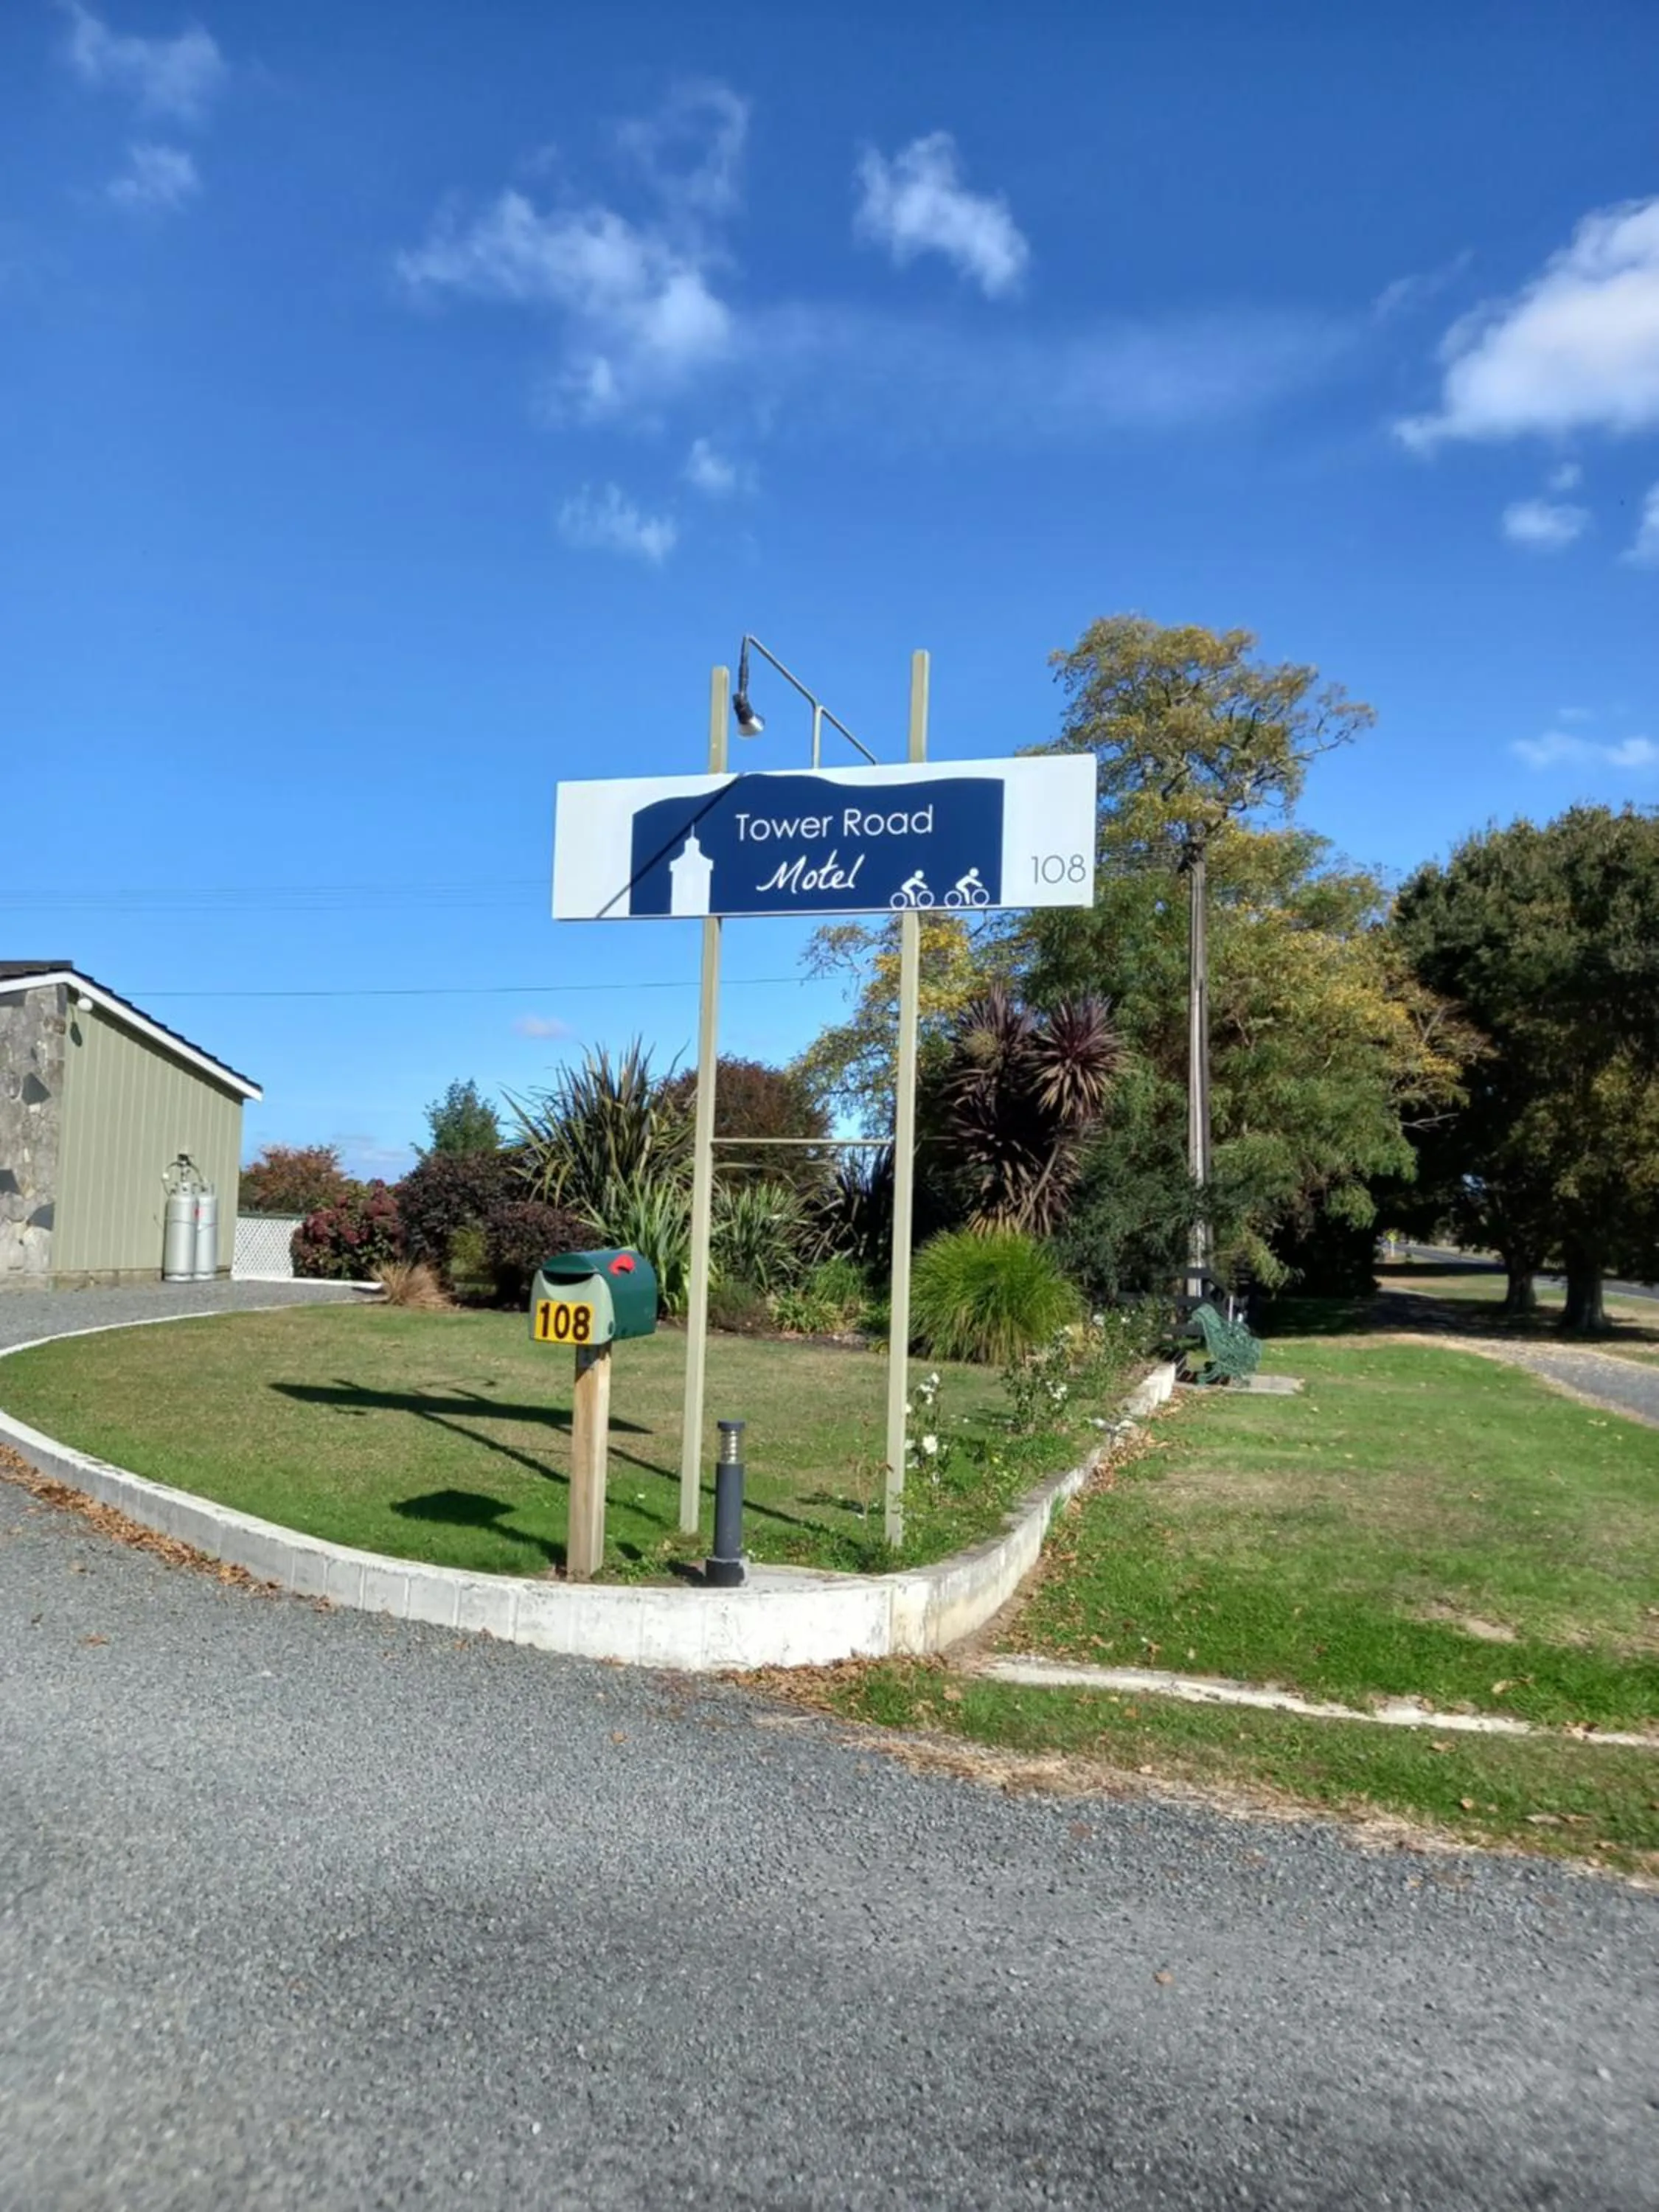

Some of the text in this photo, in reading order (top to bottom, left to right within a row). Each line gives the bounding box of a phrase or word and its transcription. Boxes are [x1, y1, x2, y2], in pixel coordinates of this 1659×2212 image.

[735, 804, 933, 841] Tower Road
[756, 849, 865, 894] Motel
[1031, 854, 1086, 885] 108
[540, 1302, 591, 1341] 108
